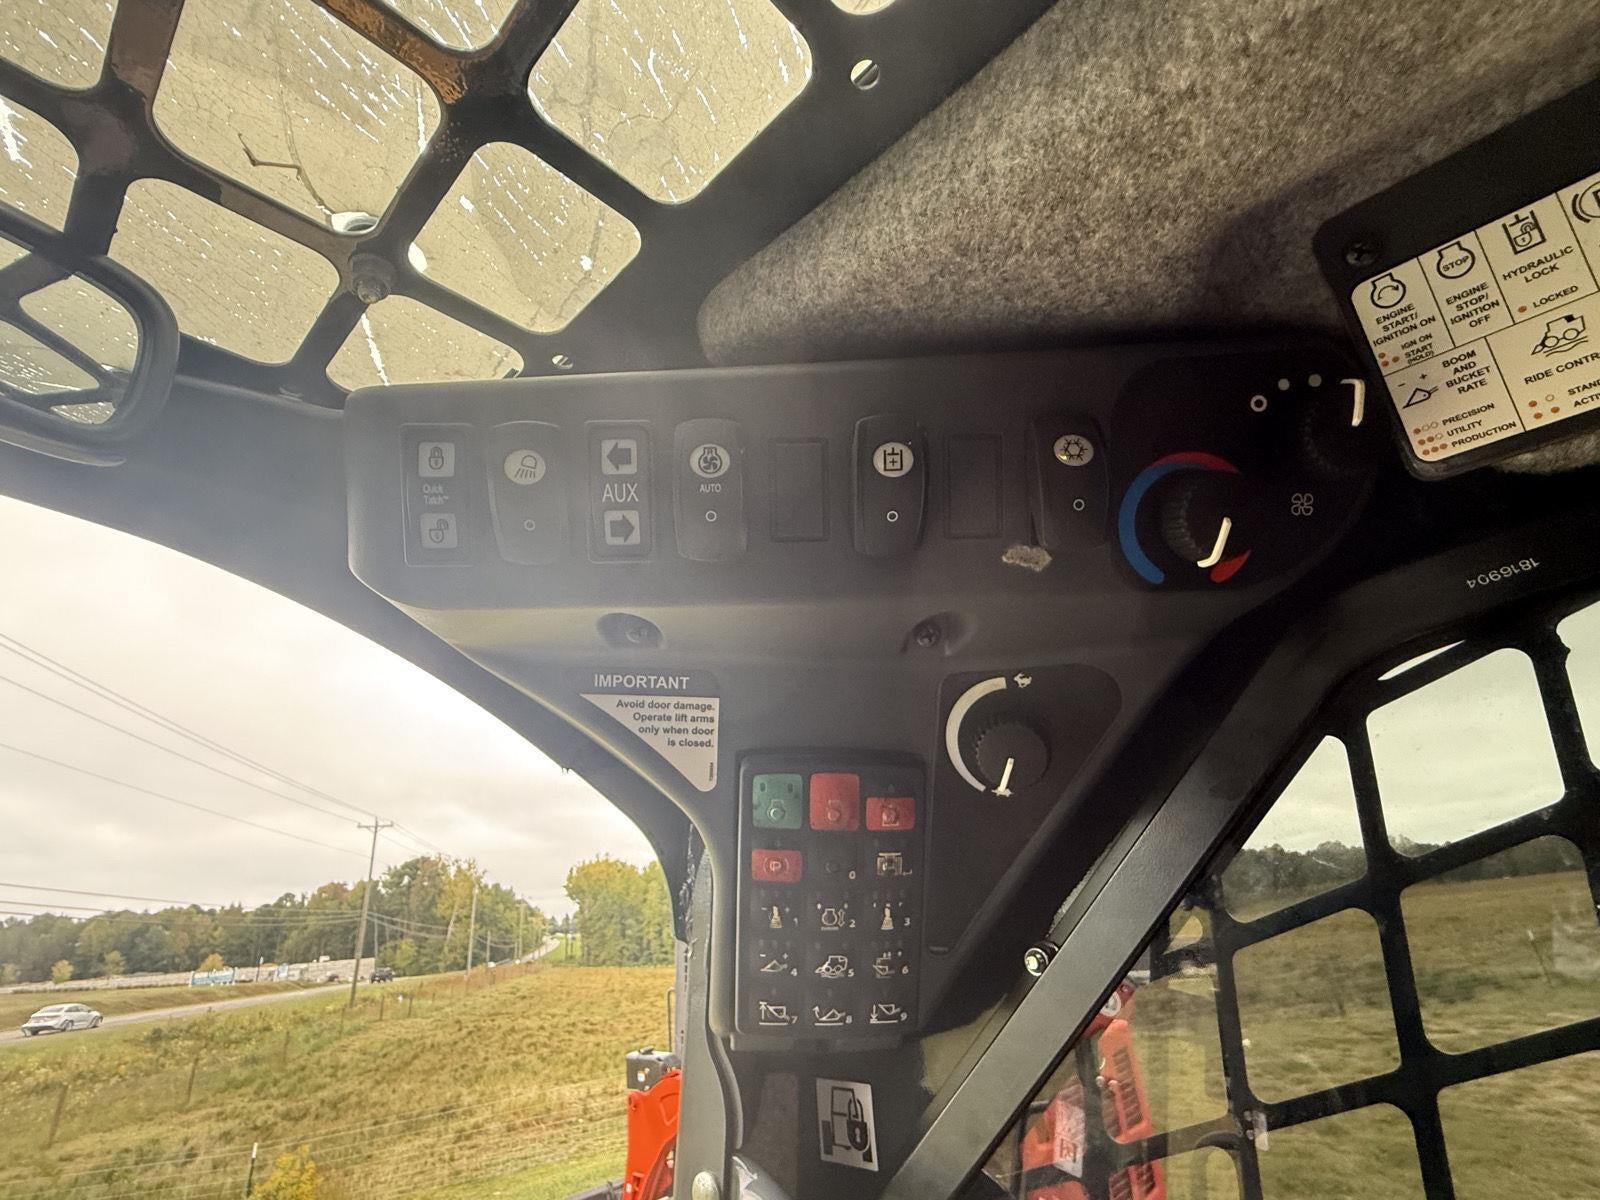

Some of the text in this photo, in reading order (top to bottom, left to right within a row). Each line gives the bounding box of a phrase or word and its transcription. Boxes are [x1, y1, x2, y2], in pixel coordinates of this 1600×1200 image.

[1442, 255, 1470, 272] STOP
[1502, 245, 1574, 281] HYDRAULIC
[1523, 262, 1560, 283] LOCK
[1446, 281, 1489, 305] ENGINE
[1455, 292, 1489, 312] STOP/
[1532, 285, 1579, 308] LOCKED
[1376, 303, 1415, 325] ENGINE
[1450, 299, 1500, 325] IGNITION
[1469, 313, 1491, 328] OFF
[1373, 315, 1437, 347] IGNITION ON
[1382, 312, 1418, 332] START/
[1401, 339, 1417, 350] IGN
[1404, 342, 1433, 359] START
[1441, 349, 1477, 368] BOOM
[1453, 360, 1477, 376] AND
[1446, 365, 1491, 388] BUCKET
[1524, 368, 1554, 385] RIDE
[1457, 378, 1488, 395] RATE
[1442, 402, 1495, 426] PRECISION
[1447, 419, 1483, 437] UTILITY
[1451, 421, 1517, 448] PRODUCTION
[602, 483, 639, 502] AUX
[699, 483, 721, 493] AUTO
[1465, 558, 1540, 589] 1816904
[594, 674, 690, 690] IMPORTANT
[616, 699, 715, 712] Avoid door damage.
[633, 712, 715, 723] Operate lift arms
[638, 725, 715, 736] only when door
[667, 738, 714, 748] is closed.
